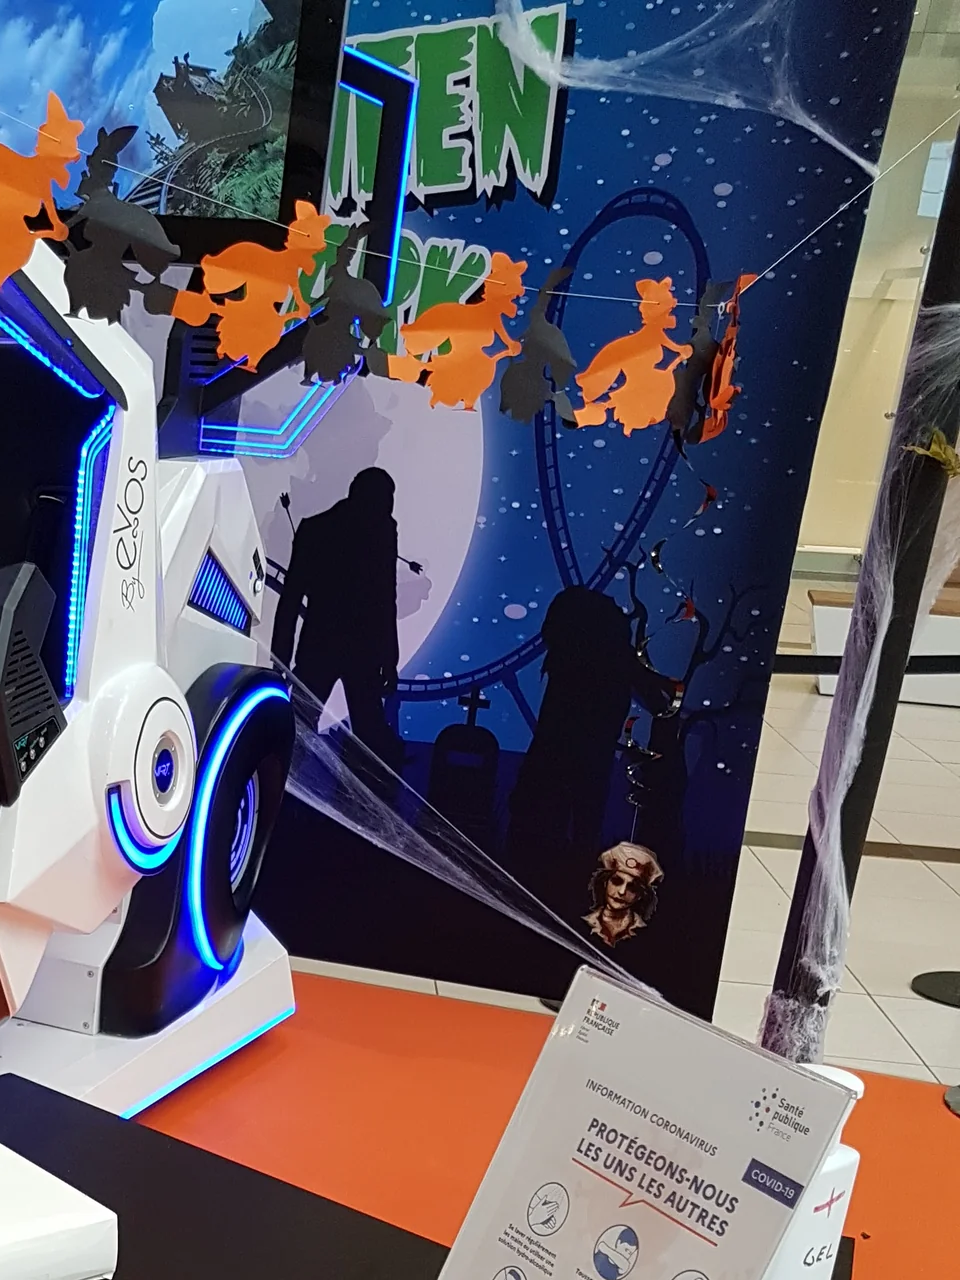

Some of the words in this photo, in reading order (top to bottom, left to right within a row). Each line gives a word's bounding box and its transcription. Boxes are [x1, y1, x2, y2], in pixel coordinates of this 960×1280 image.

[582, 1016, 615, 1037] FRANÇAISE
[586, 1008, 621, 1030] RPUBLIQUE
[585, 1078, 649, 1120] INFORMATION
[650, 1113, 718, 1158] CORONAVIRUS
[777, 1097, 806, 1119] Santé
[766, 1124, 792, 1143] France
[771, 1111, 811, 1137] publique
[588, 1117, 740, 1214] PROTÉGEONS-NOUS
[575, 1137, 603, 1162] LES
[603, 1152, 639, 1183] UNS
[637, 1172, 666, 1200] LES
[663, 1190, 730, 1238] AUTRES
[751, 1168, 796, 1199] COVID-19
[803, 1244, 833, 1267] GEL
